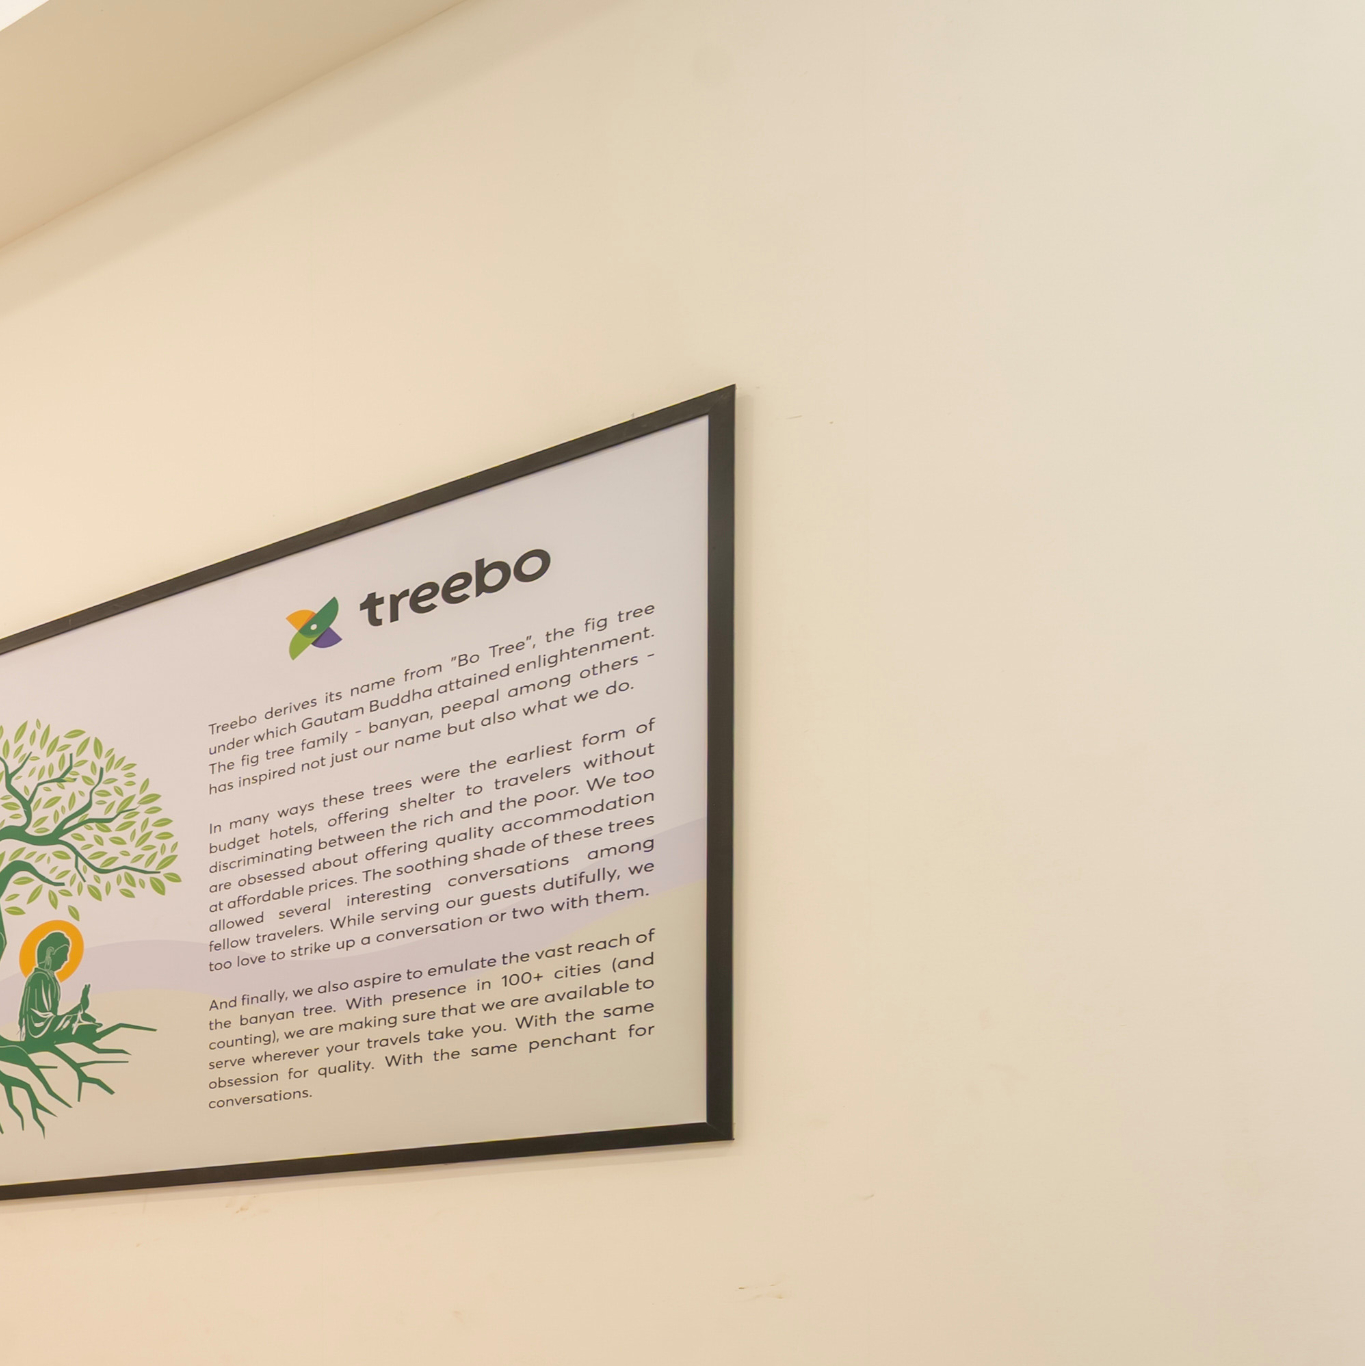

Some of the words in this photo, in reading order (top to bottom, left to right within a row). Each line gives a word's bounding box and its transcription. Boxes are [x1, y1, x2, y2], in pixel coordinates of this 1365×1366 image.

[360, 548, 551, 627] treebo
[207, 715, 257, 735] Treebo
[264, 698, 317, 720] derives
[325, 691, 343, 704] its
[350, 676, 395, 697] name
[403, 663, 442, 682] from
[545, 627, 575, 643] the
[584, 617, 608, 632] fig
[617, 604, 655, 623] tree
[208, 736, 250, 755] under
[253, 722, 297, 743] which
[301, 706, 364, 730] Gautam
[369, 687, 432, 713] Buddha
[437, 663, 510, 694] attained
[515, 626, 654, 673] enlightenment.
[208, 761, 235, 775] The
[240, 754, 259, 767] fig
[265, 745, 295, 760] tree
[300, 730, 348, 751] family
[368, 710, 433, 734] banyan,
[441, 688, 499, 719] peepal
[507, 673, 571, 698] among
[579, 655, 638, 679] others
[209, 781, 234, 795] has
[238, 761, 295, 788] inspired
[301, 755, 326, 772] not
[329, 747, 358, 768] just
[362, 741, 389, 756] our
[394, 729, 441, 749] name
[447, 718, 475, 736] but
[480, 710, 516, 727] also
[522, 694, 568, 716] what
[573, 689, 599, 703] we
[605, 680, 634, 695] do.
[209, 823, 222, 835] In
[229, 812, 269, 830] many
[277, 802, 315, 818] ways
[322, 790, 364, 808] these
[372, 779, 412, 796] trees
[420, 768, 460, 785] were
[469, 759, 497, 774] the
[506, 739, 572, 765] earliest
[581, 728, 625, 747] form
[635, 716, 656, 734] of
[208, 843, 313, 874] discriminating
[318, 828, 385, 850] between
[390, 820, 417, 835] the
[423, 810, 453, 828] rich
[459, 800, 492, 820] and
[498, 796, 527, 811] the
[534, 785, 579, 807] poor.
[586, 775, 616, 792] We
[623, 768, 654, 784] too
[209, 832, 260, 854] budget
[269, 820, 317, 840] hotels,
[327, 805, 388, 827] offering
[399, 790, 455, 812] shelter
[465, 784, 483, 797] to
[494, 764, 571, 790] travelers
[582, 742, 655, 770] without
[209, 881, 232, 893] are
[237, 861, 305, 887] obsessed
[311, 852, 358, 872] about
[364, 840, 428, 861] offering
[435, 825, 494, 848] quality
[501, 792, 654, 833] accommodation
[208, 910, 264, 933] allowed
[278, 897, 331, 920] several
[346, 882, 431, 907] interesting
[447, 855, 569, 887] conversations
[587, 838, 654, 860] among
[208, 937, 251, 952] fellow
[255, 924, 324, 944] travelers.
[329, 912, 375, 930] While
[380, 902, 439, 921] serving
[445, 895, 474, 909] our
[479, 883, 536, 906] guests
[542, 866, 620, 891] dutifully,
[627, 862, 654, 875] we
[209, 900, 224, 913] at
[227, 884, 304, 909] affordable
[308, 876, 357, 896] prices.
[361, 868, 392, 882] The
[395, 853, 468, 876] soothing
[473, 840, 526, 861] shade
[530, 832, 549, 849] of
[553, 826, 603, 845] these
[607, 815, 655, 833] trees
[208, 960, 232, 972] too
[237, 954, 266, 967] love
[270, 950, 286, 961] to
[290, 941, 331, 958] strike
[335, 938, 355, 951] up
[360, 935, 371, 946] a
[375, 916, 483, 943] conversation
[488, 911, 507, 923] or
[511, 905, 544, 920] two
[550, 894, 589, 912] with
[595, 887, 649, 905] them.
[208, 995, 237, 1011] And
[240, 989, 288, 1006] finally,
[292, 987, 313, 998] we
[317, 980, 349, 994] also
[353, 972, 402, 989] aspire
[406, 968, 423, 980] to
[427, 956, 497, 977] emulate
[501, 951, 530, 965] the
[534, 943, 573, 960] vast
[577, 933, 630, 954] reach
[635, 927, 656, 944] of
[208, 1018, 232, 1031] the
[239, 1010, 294, 1026] banyan
[302, 1004, 336, 1017] tree.
[345, 993, 382, 1010] With
[392, 984, 467, 1007] presence
[476, 978, 491, 991] in
[501, 971, 544, 987] 100+
[553, 963, 601, 980] cities
[611, 951, 654, 973] (and
[208, 1029, 279, 1050] counting),
[283, 1029, 305, 1039] we
[308, 1025, 334, 1036] are
[338, 1015, 397, 1032] making
[402, 1010, 436, 1023] sure
[440, 1002, 476, 1018] that
[481, 1000, 505, 1012] we
[510, 995, 539, 1008] are
[544, 979, 629, 1003] available
[635, 977, 654, 990] to
[208, 1057, 245, 1070] serve
[251, 1047, 320, 1064] wherever
[325, 1041, 360, 1057] your
[366, 1030, 420, 1049] travels
[427, 1026, 464, 1041] take
[471, 1022, 507, 1038] you.
[514, 1012, 557, 1029] With
[564, 1008, 595, 1023] the
[603, 1002, 654, 1018] same
[208, 1072, 279, 1089] obsession
[287, 1067, 309, 1080] for
[317, 1060, 375, 1078] quality.
[384, 1051, 423, 1067] With
[433, 1048, 461, 1062] the
[470, 1043, 518, 1057] same
[528, 1027, 616, 1054] penchant
[628, 1023, 655, 1038] for
[208, 1089, 312, 1109] conversations.
